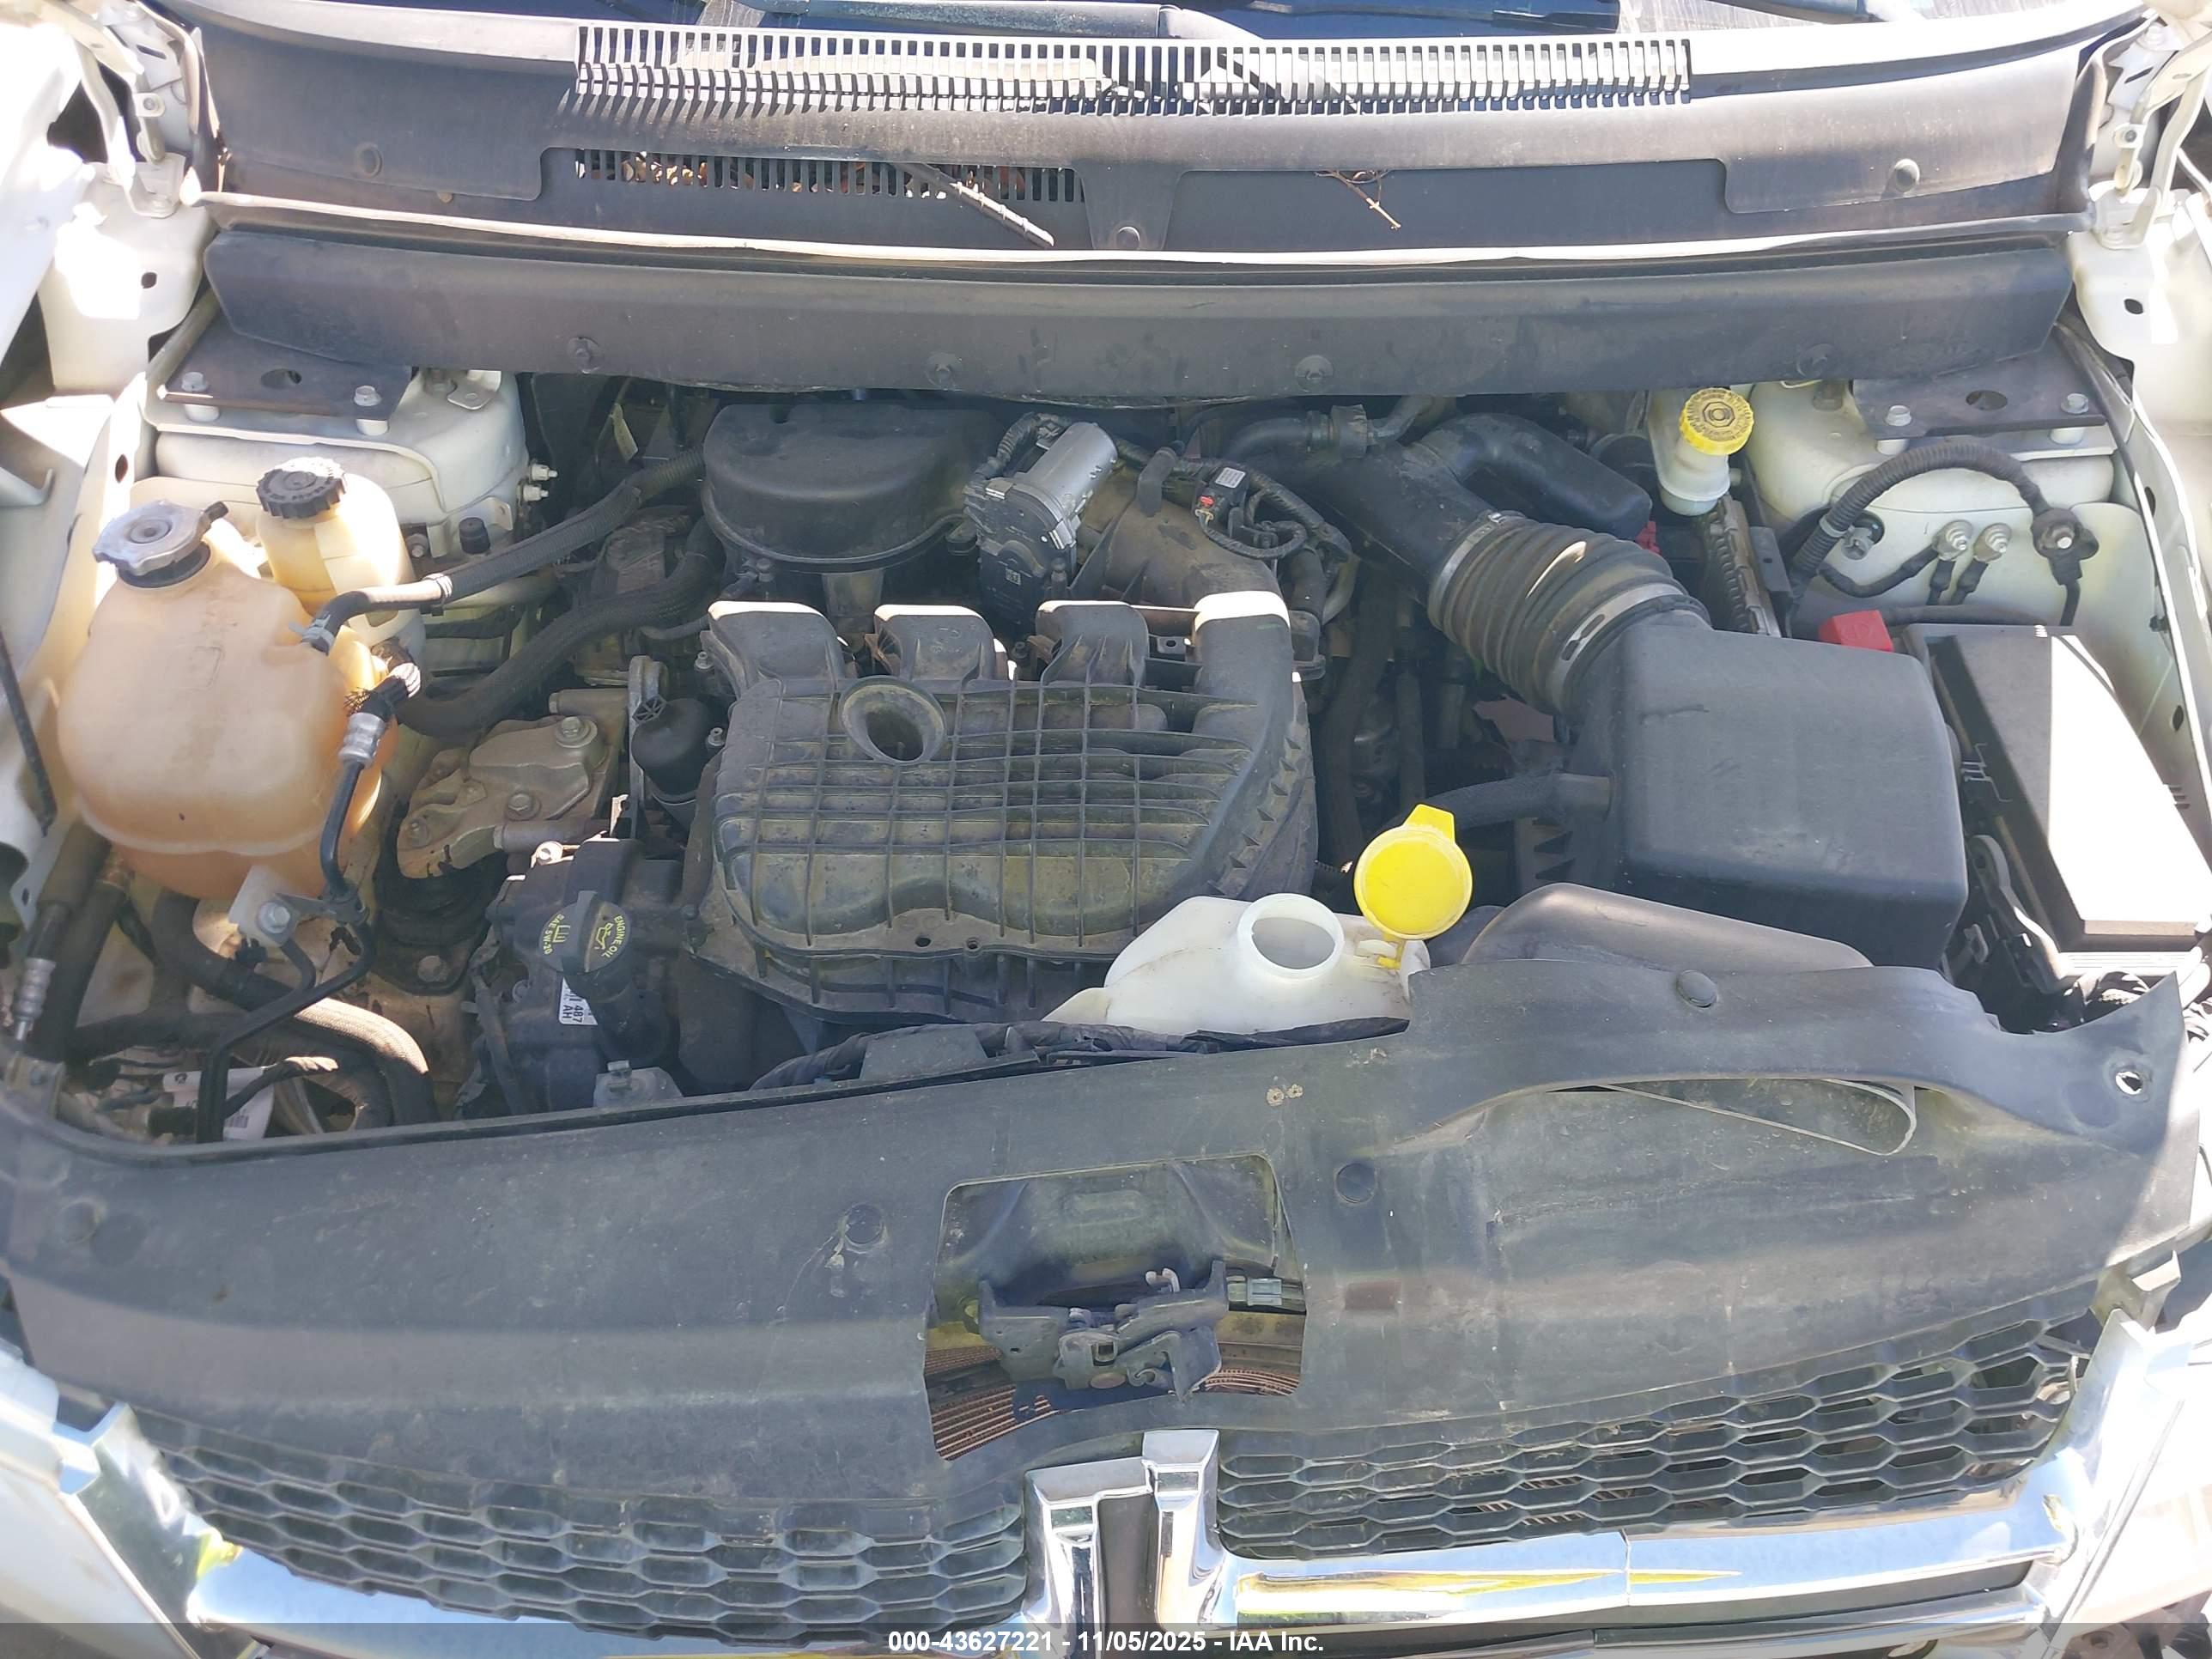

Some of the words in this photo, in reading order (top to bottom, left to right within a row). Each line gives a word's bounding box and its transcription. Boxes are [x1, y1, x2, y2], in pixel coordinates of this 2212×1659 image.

[549, 914, 565, 928] SAE
[611, 915, 625, 945] ENGINE
[543, 930, 553, 954] 5W-20
[601, 945, 617, 958] OIL
[562, 1005, 574, 1018] AH
[573, 1005, 584, 1023] 487
